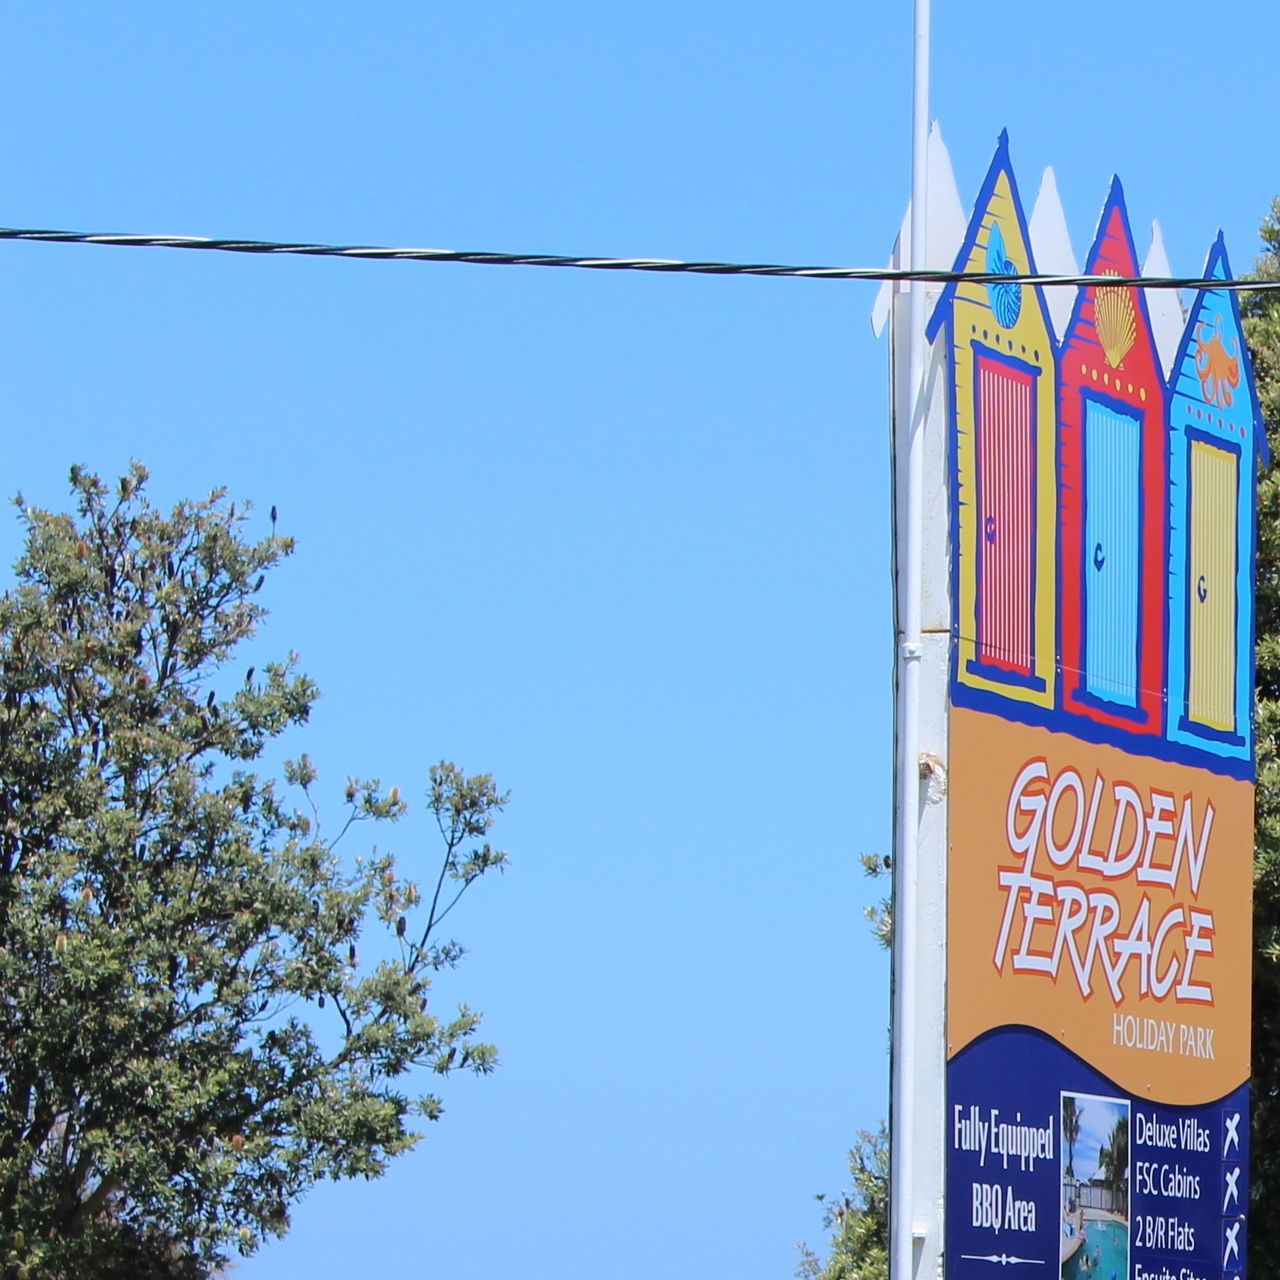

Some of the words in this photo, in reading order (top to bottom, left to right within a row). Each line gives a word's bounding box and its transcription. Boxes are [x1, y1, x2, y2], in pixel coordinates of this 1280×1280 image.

[1006, 756, 1216, 900] GOLDEN
[992, 864, 1216, 1007] TERRACE
[1113, 1013, 1176, 1054] HOLIDAY
[1180, 1026, 1215, 1060] PARK
[954, 1104, 988, 1167] Fully
[990, 1109, 1054, 1172] Equipped
[1136, 1113, 1177, 1149] Deluxe
[1179, 1118, 1210, 1153] Villas
[1136, 1162, 1158, 1196] FSC
[1160, 1164, 1200, 1200] Cabins
[972, 1183, 1002, 1235] BBQ
[1005, 1186, 1036, 1232] Area
[1135, 1216, 1144, 1247] 2
[1145, 1217, 1166, 1249] B/R
[1168, 1220, 1195, 1251] Flats
